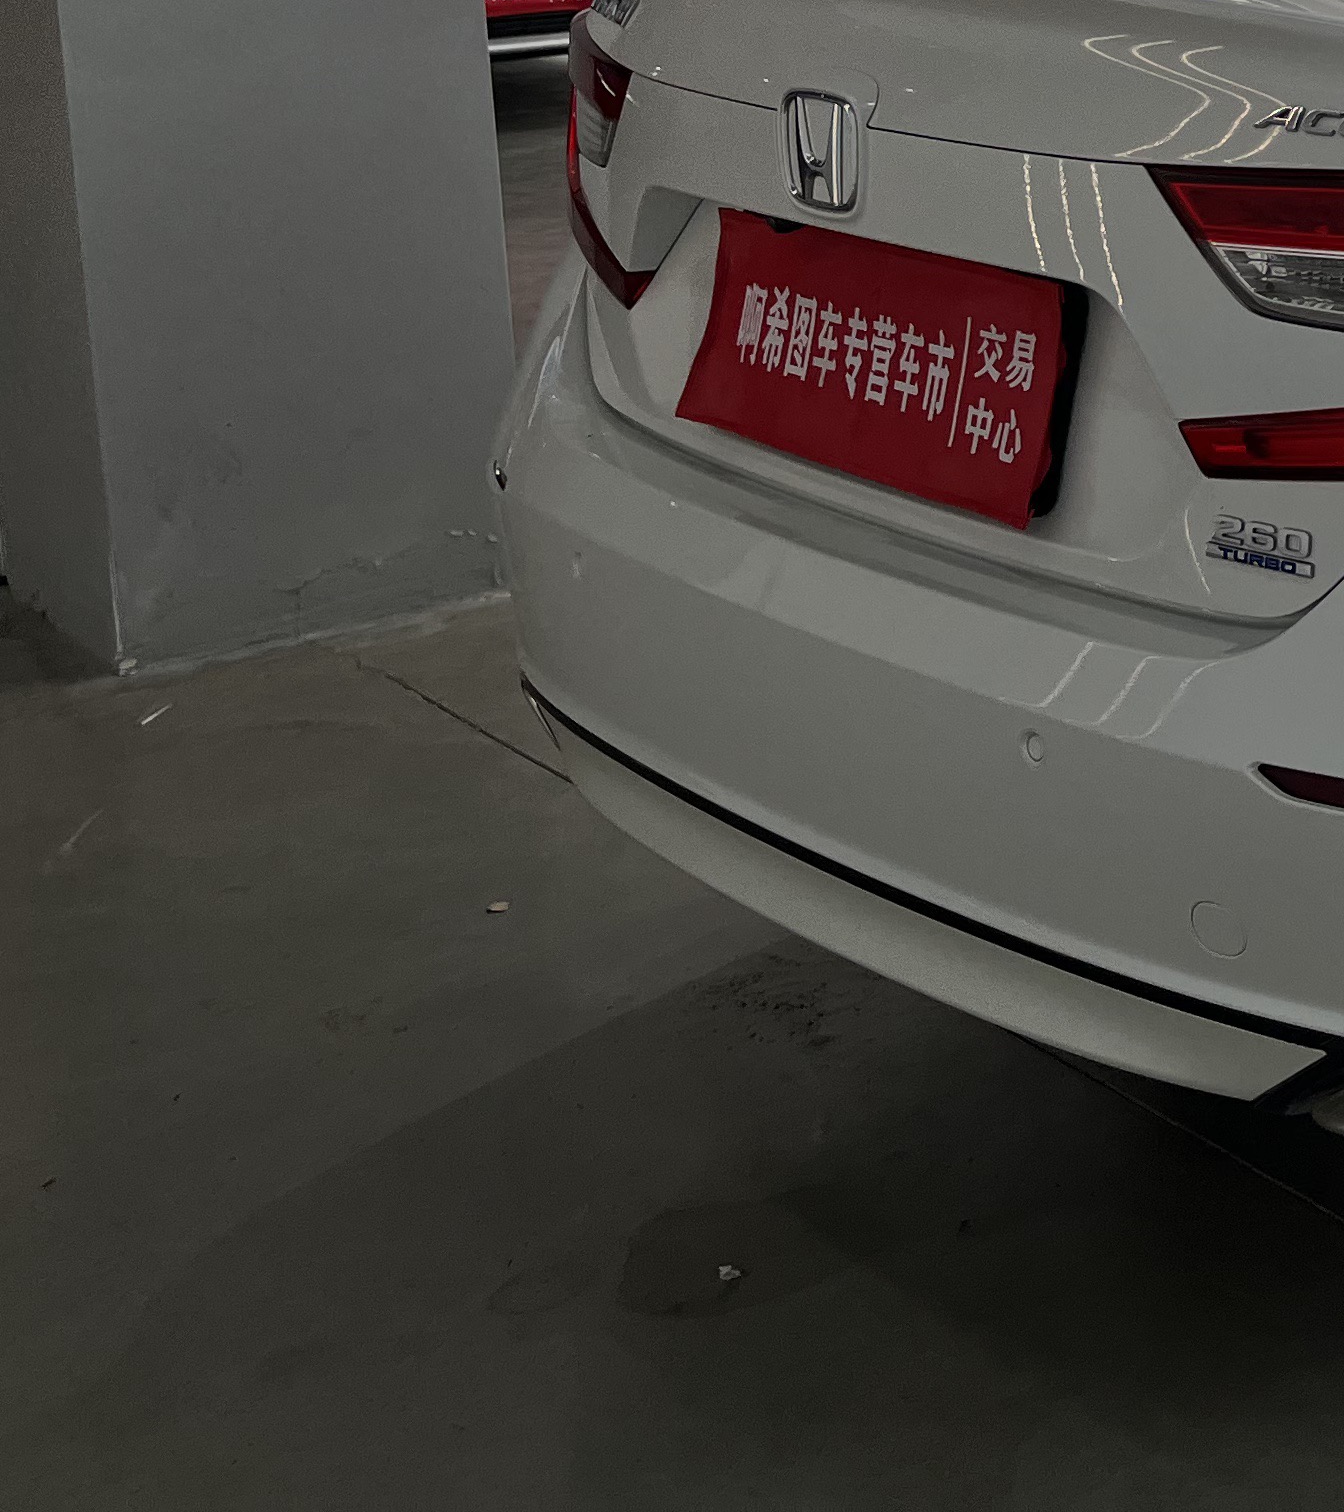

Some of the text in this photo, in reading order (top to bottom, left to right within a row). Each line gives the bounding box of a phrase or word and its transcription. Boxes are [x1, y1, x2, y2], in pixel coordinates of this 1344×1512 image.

[973, 323, 1038, 392] 交易
[963, 397, 1023, 464] 中心
[1211, 513, 1313, 559] 260
[1218, 546, 1297, 574] TURBO
